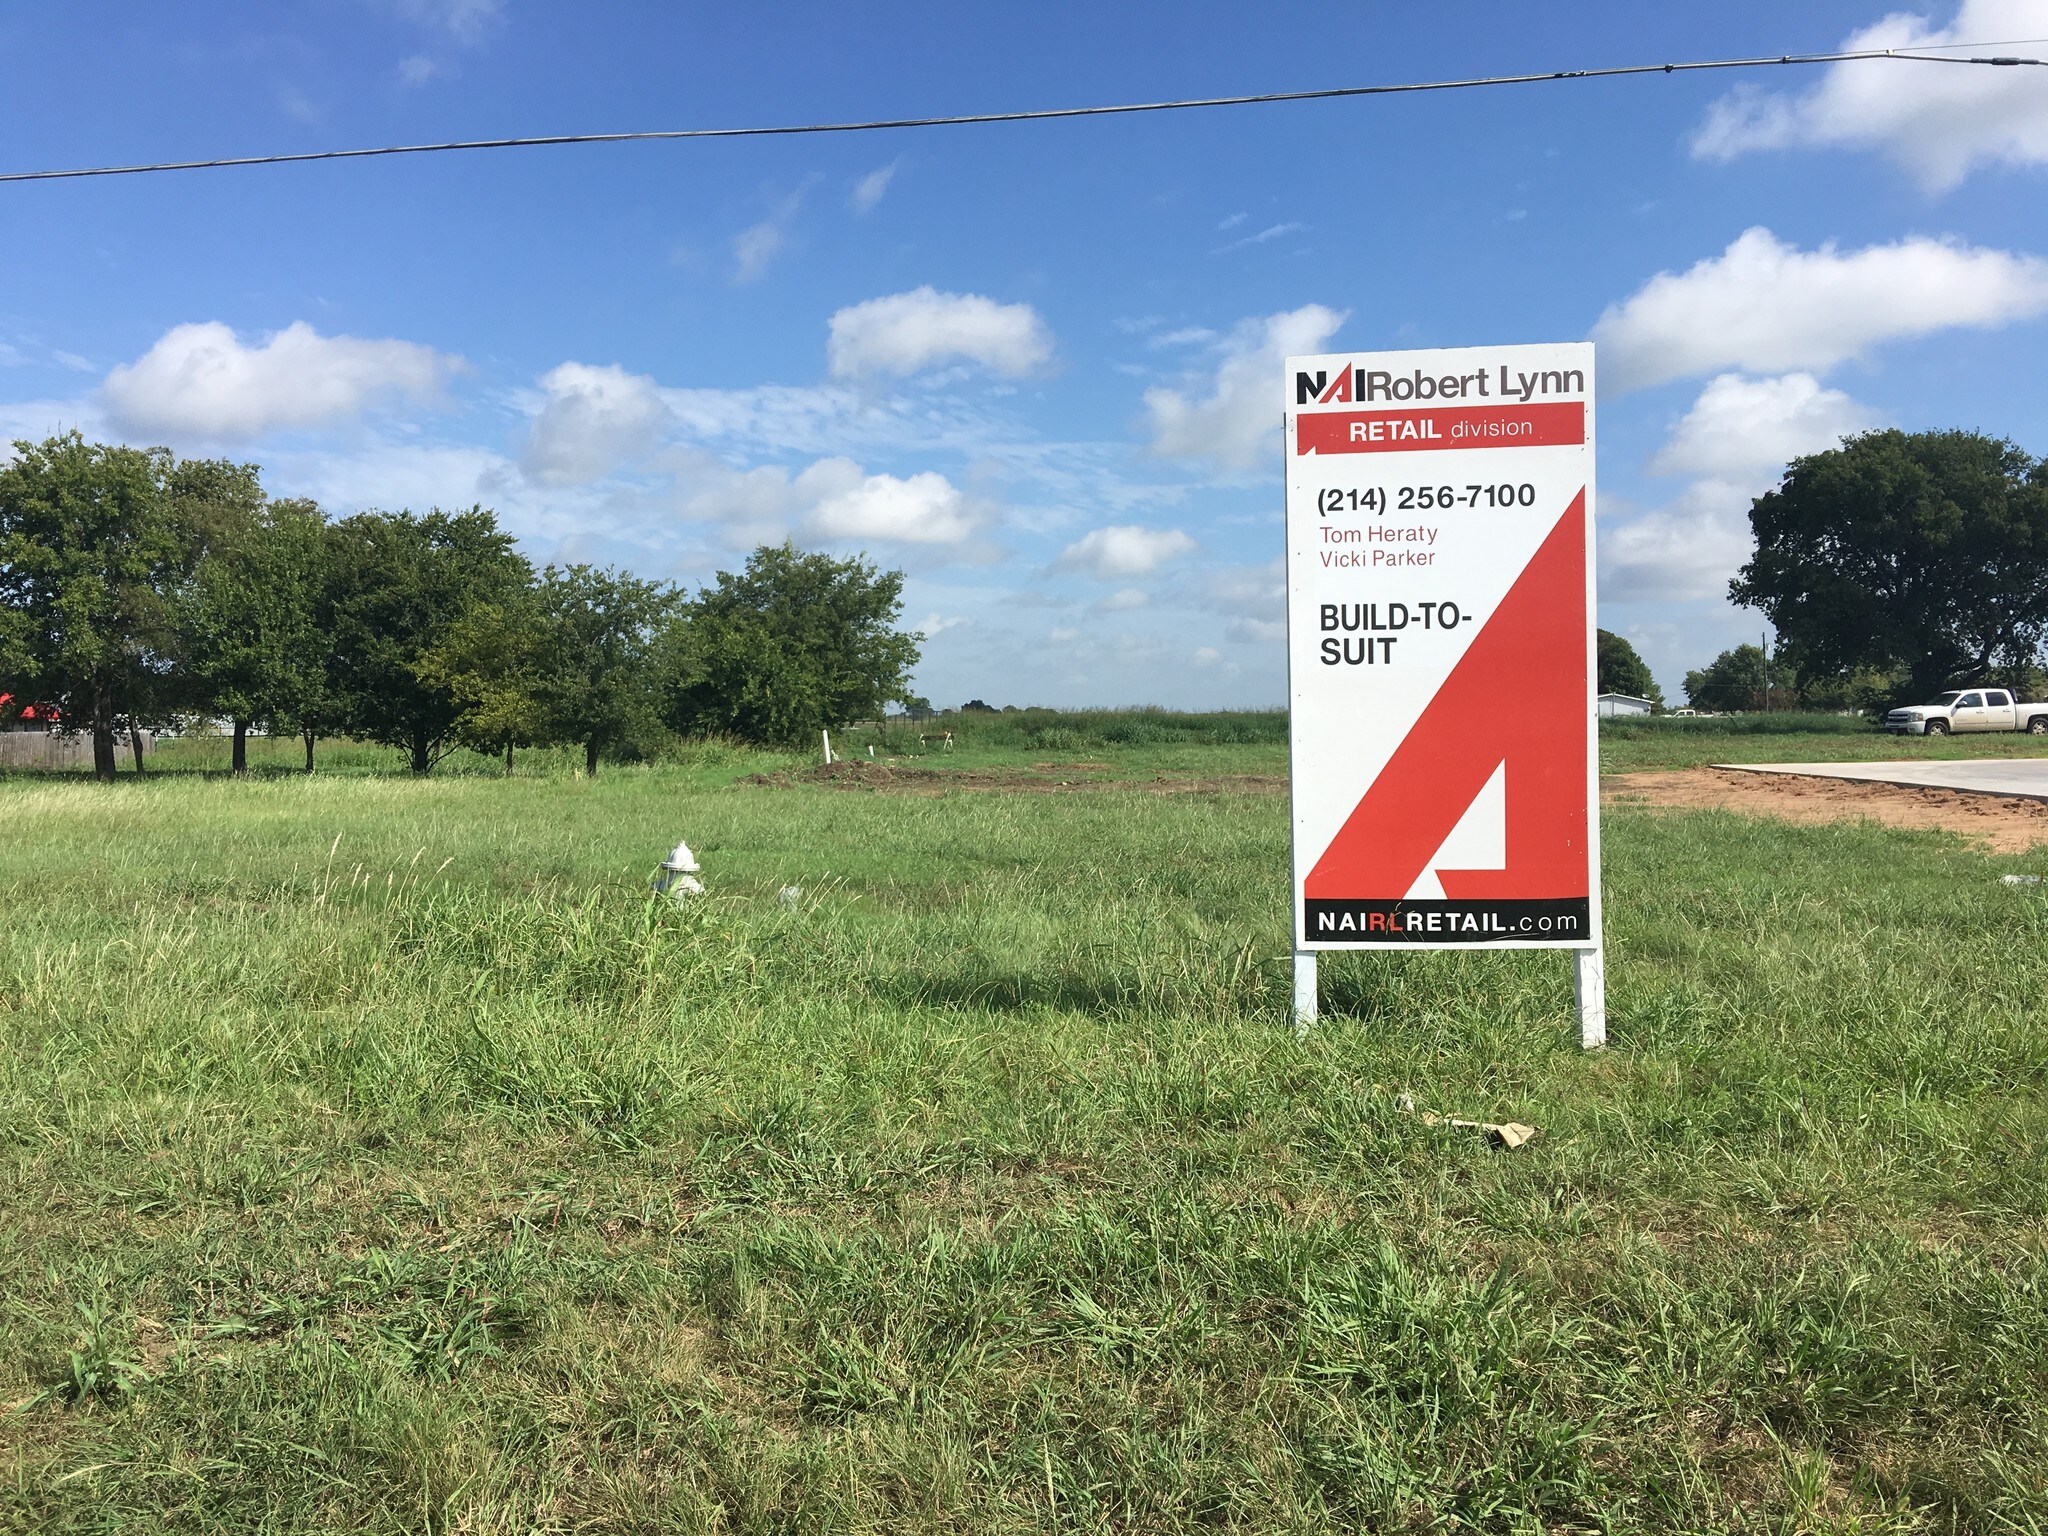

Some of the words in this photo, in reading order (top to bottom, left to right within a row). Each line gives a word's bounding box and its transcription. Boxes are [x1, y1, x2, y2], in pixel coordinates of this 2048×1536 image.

[1500, 366, 1584, 402] Lynn
[1349, 420, 1442, 442] RETAIL
[1451, 419, 1532, 438] division
[1317, 487, 1386, 517] (214)
[1398, 483, 1536, 510] 256-7100
[1320, 527, 1362, 543] Tom
[1369, 525, 1438, 545] Heraty
[1320, 550, 1366, 568] Vicki
[1373, 550, 1435, 566] Parker
[1321, 602, 1472, 631] BUILD-TO-
[1320, 638, 1397, 665] SUIT
